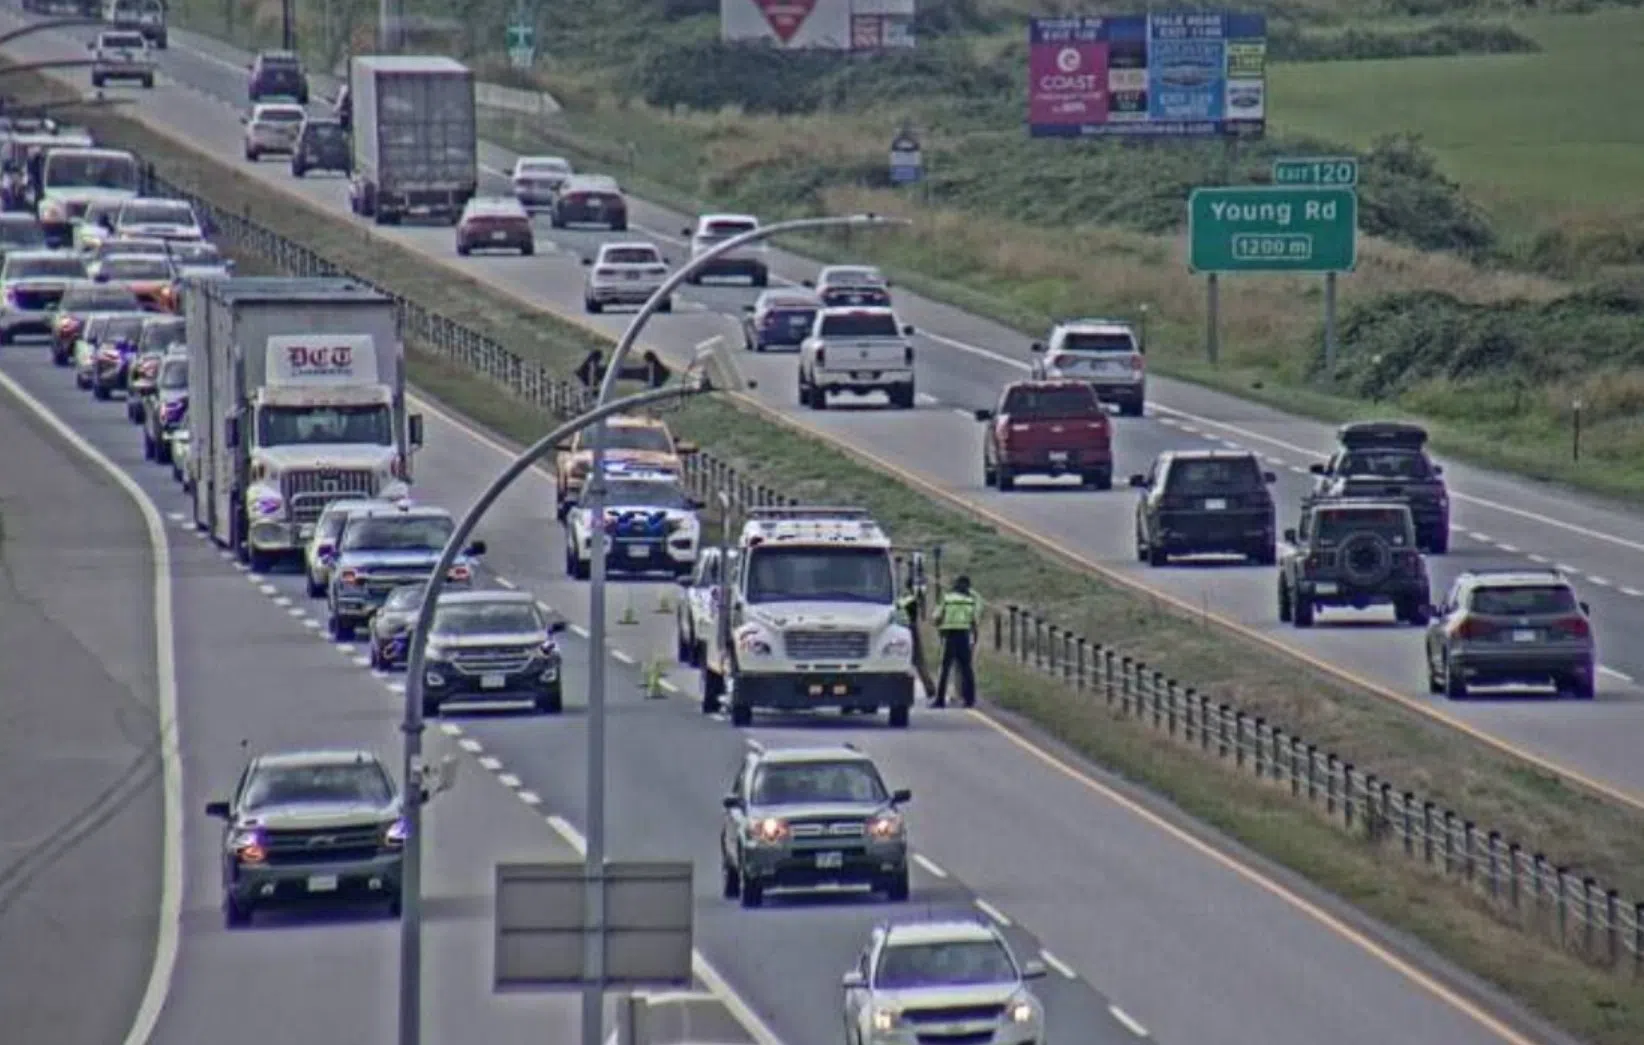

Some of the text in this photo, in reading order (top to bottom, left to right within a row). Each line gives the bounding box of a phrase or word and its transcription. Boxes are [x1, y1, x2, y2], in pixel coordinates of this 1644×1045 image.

[1040, 75, 1096, 90] COAST
[1277, 163, 1351, 182] EXIT 120
[1210, 200, 1337, 225] Young Rd
[1238, 239, 1306, 254] 1200 m
[287, 346, 353, 367] DCT
